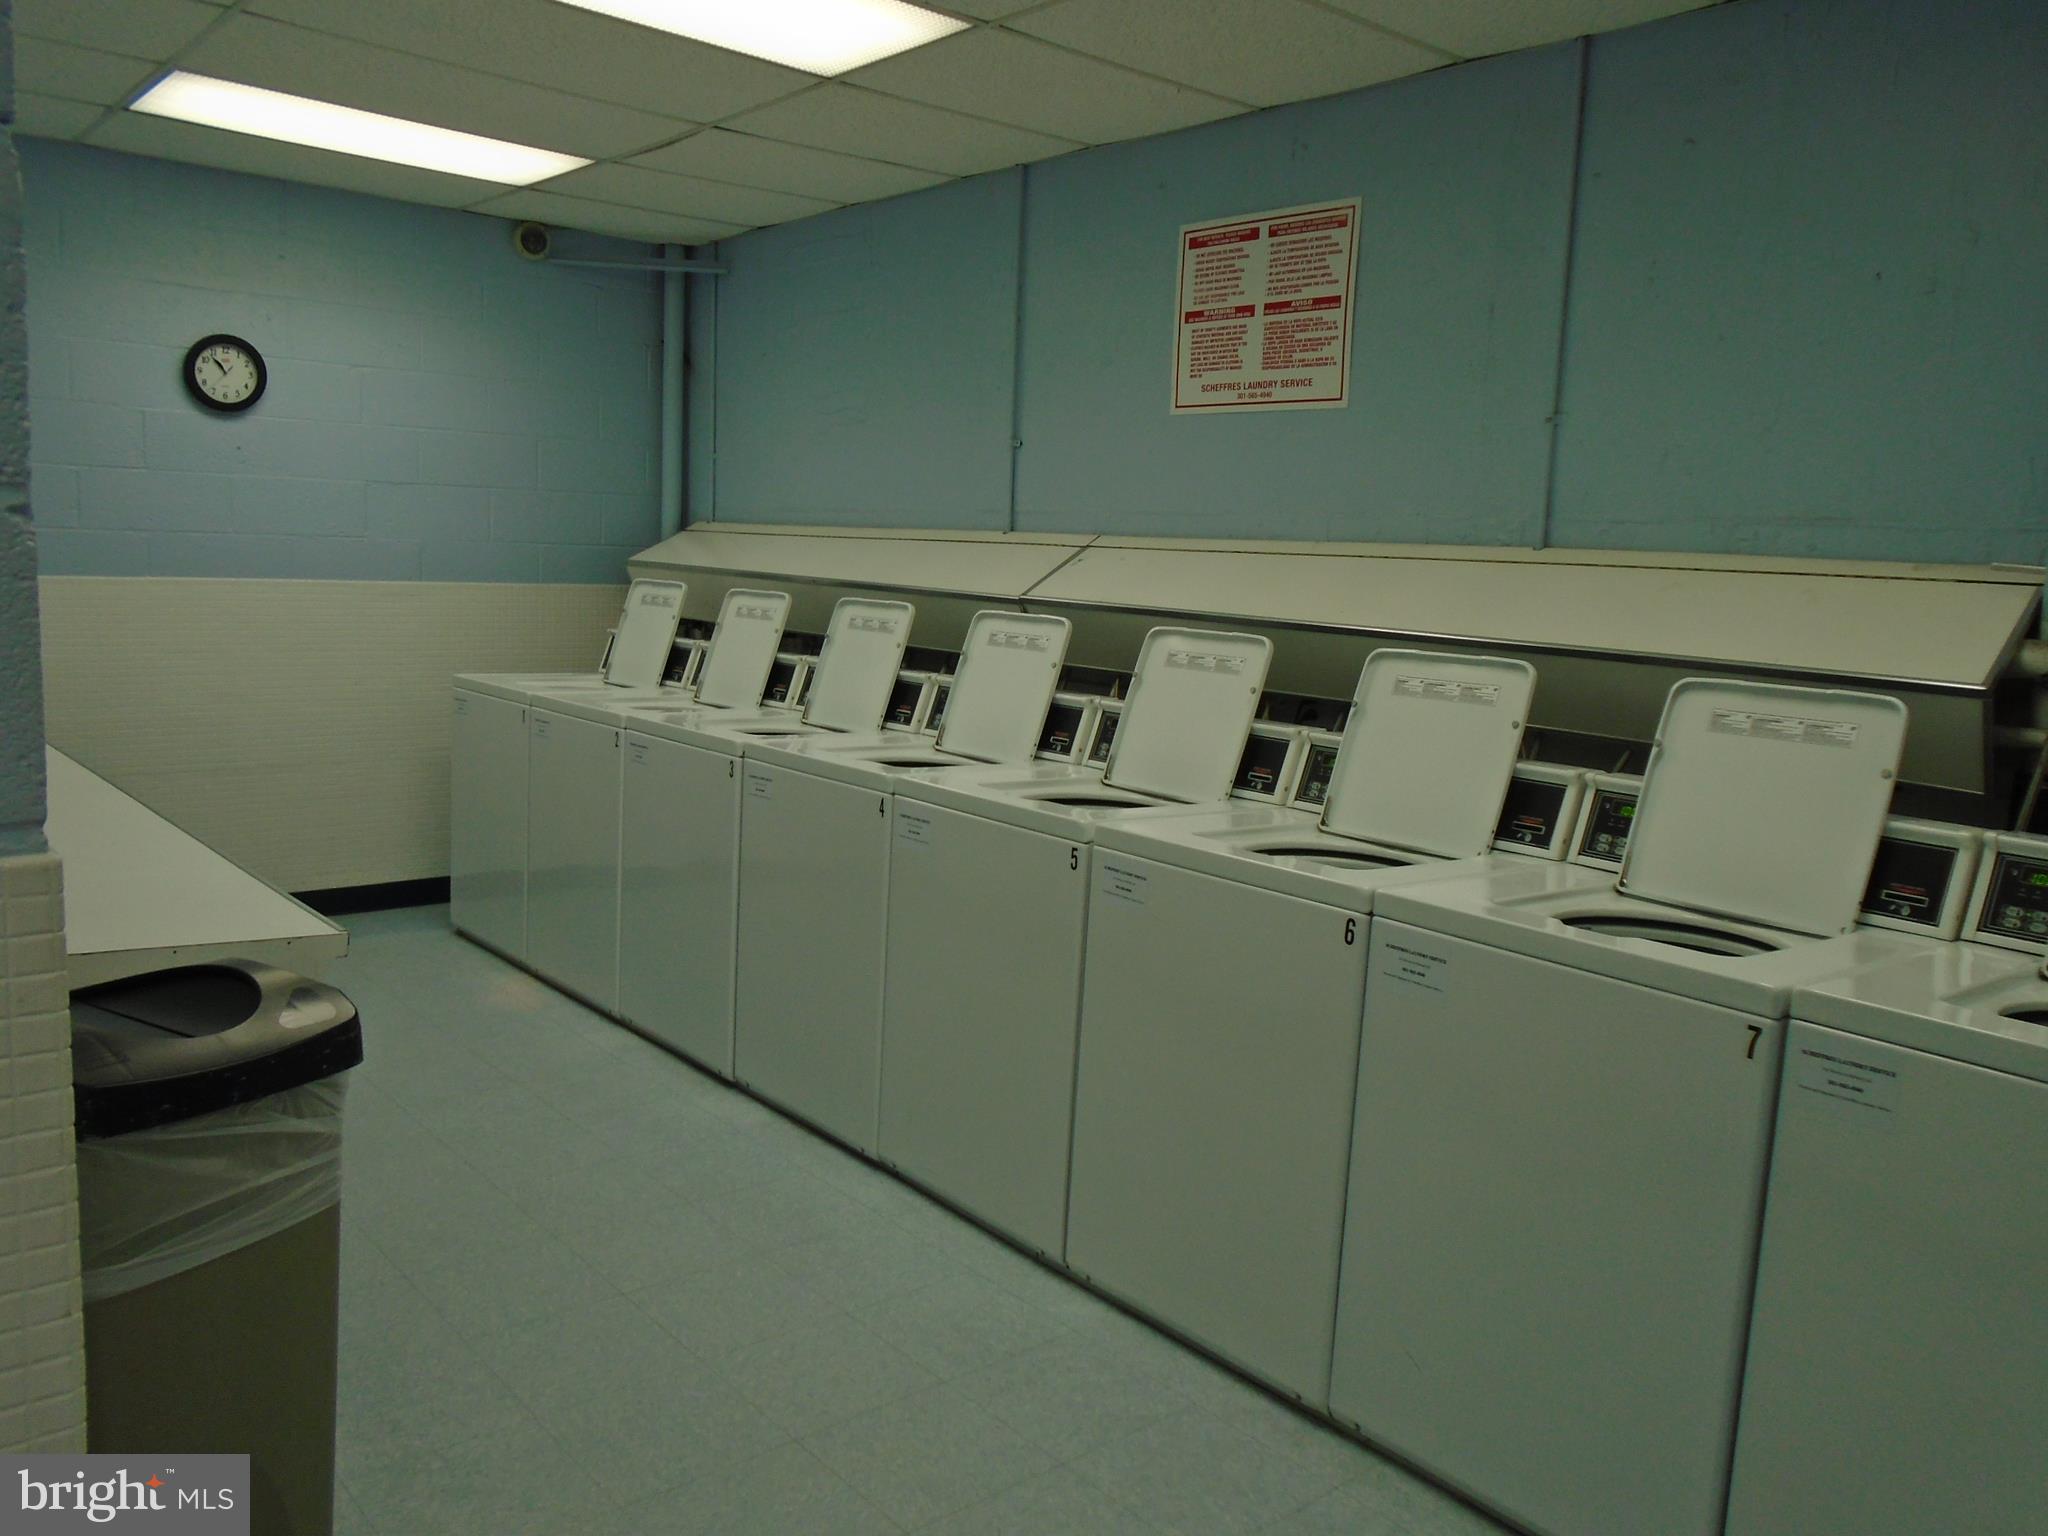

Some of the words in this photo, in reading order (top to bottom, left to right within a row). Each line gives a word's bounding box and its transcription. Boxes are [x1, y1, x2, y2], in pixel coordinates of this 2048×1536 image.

[1290, 299, 1313, 307] AVISO
[1203, 307, 1236, 316] WARNING
[210, 348, 217, 356] 11
[222, 346, 230, 354] 12
[1201, 382, 1241, 392] SCHEFFRES
[1243, 380, 1278, 390] LAUNDRY
[1280, 378, 1313, 388] SERVICE
[614, 732, 620, 748] 2
[729, 760, 734, 778] 3
[879, 797, 885, 818] 4
[1070, 847, 1078, 870] 5
[1343, 918, 1356, 945] 6
[1746, 1025, 1763, 1060] 7
